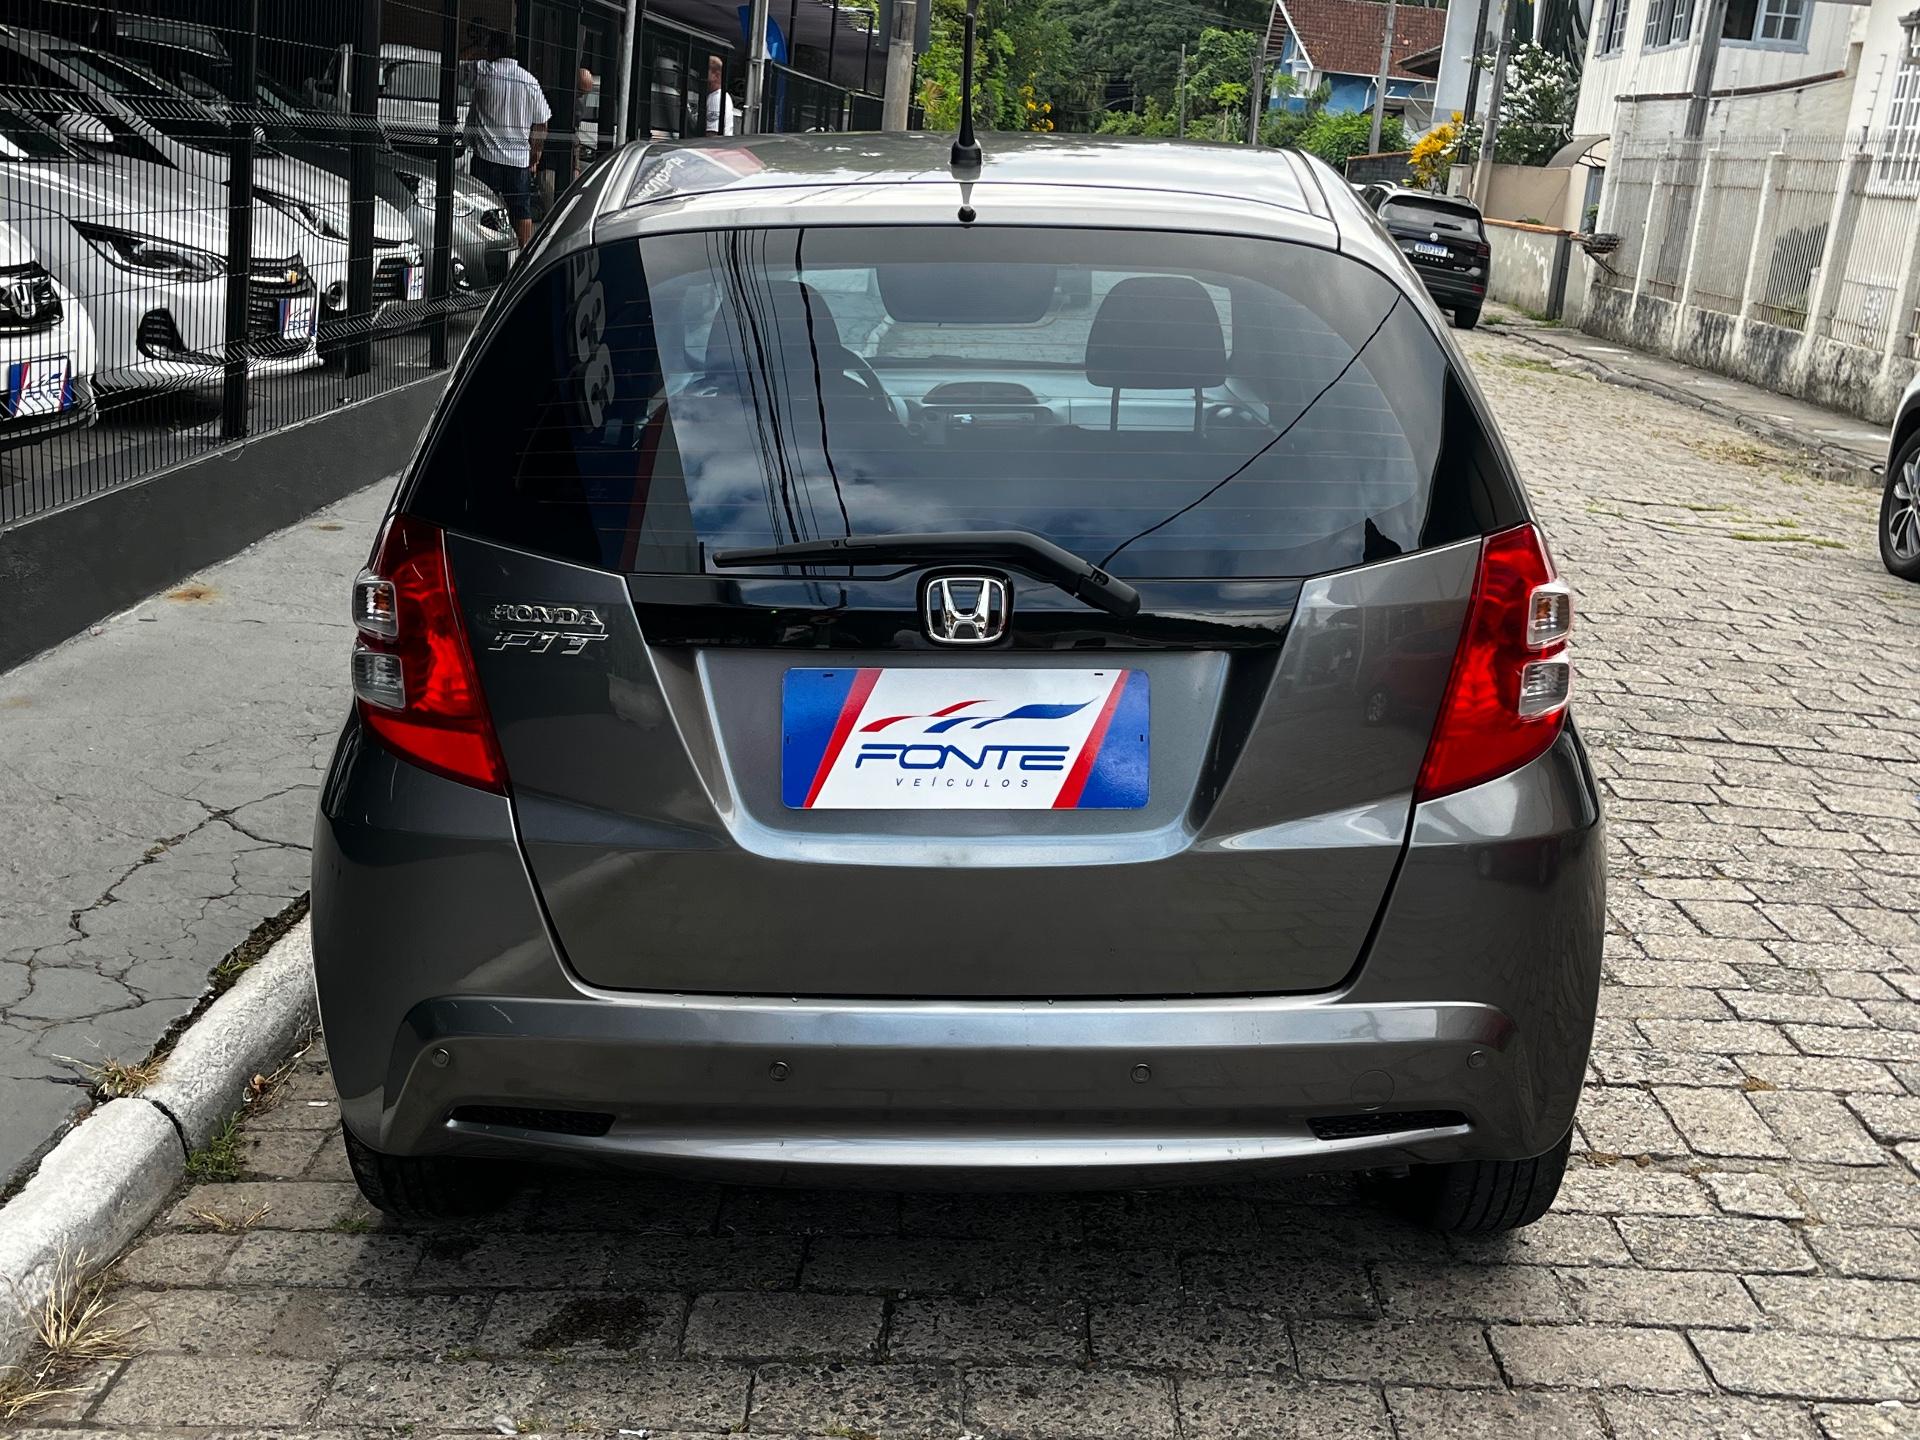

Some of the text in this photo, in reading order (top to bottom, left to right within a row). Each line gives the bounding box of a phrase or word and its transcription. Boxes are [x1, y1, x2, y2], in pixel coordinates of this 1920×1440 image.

[491, 604, 604, 625] HONDA
[487, 630, 609, 655] FIT
[855, 743, 1070, 771] FONTE
[895, 776, 1029, 788] VEÍCULOS
